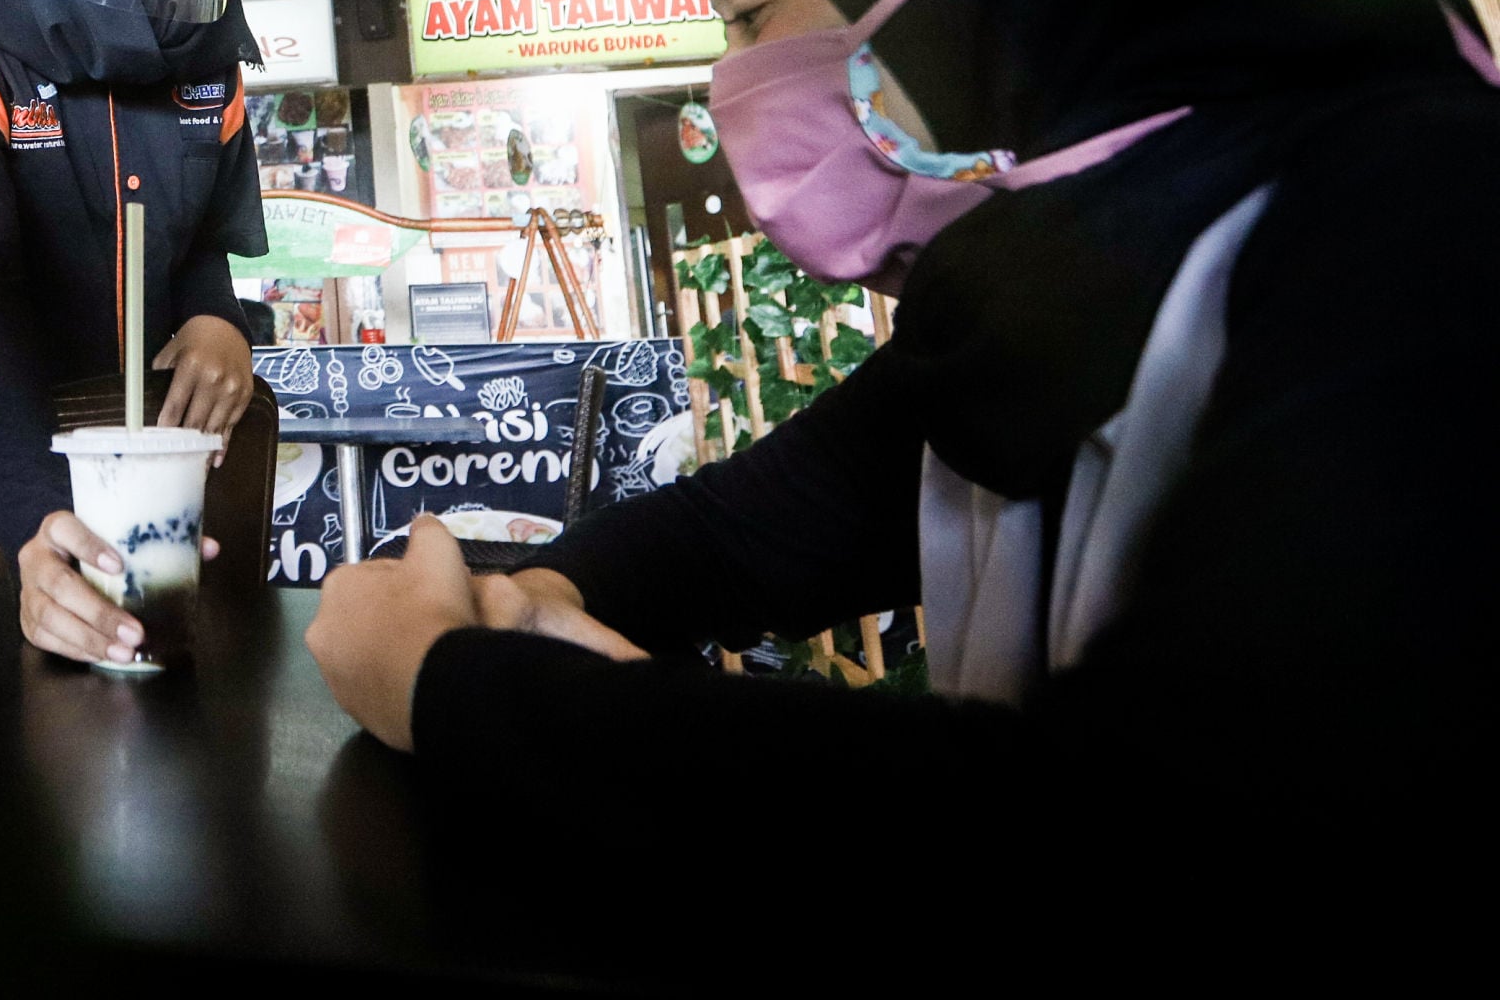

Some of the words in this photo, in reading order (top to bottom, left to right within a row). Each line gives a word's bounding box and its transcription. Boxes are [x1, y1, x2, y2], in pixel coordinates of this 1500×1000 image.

[518, 39, 599, 58] WARUNG
[603, 33, 668, 52] BUNDA
[192, 115, 211, 125] food
[212, 116, 219, 124] &
